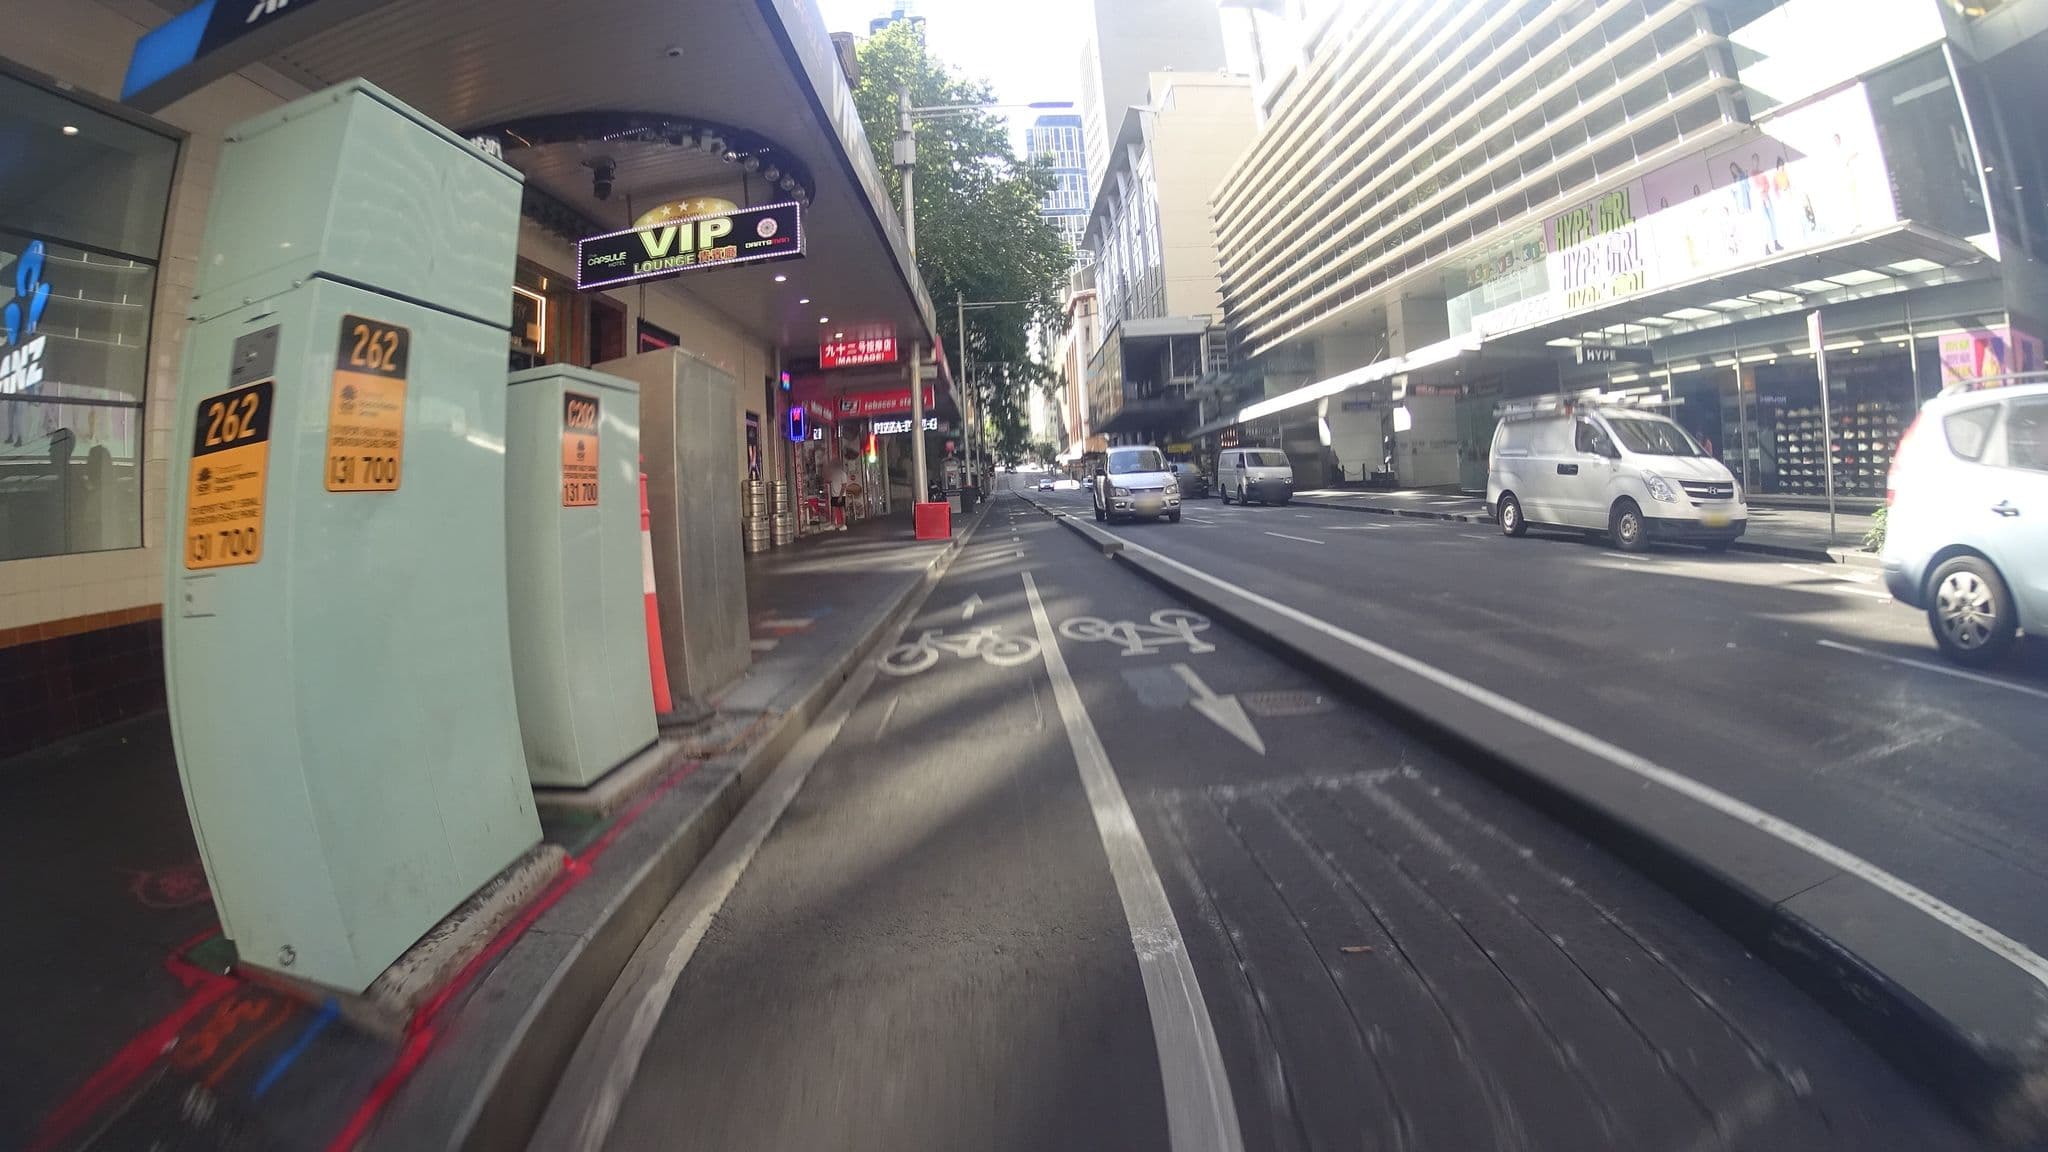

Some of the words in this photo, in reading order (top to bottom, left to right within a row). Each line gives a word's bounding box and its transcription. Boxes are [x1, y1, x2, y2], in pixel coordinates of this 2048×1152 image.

[1555, 203, 1594, 252] HYPE
[1598, 187, 1636, 234] GIRL
[638, 216, 733, 259] VIP
[587, 251, 627, 266] CAPSULE
[608, 260, 626, 268] HOTEL
[634, 252, 696, 274] LOUNGE
[1563, 241, 1605, 291] HYPE
[351, 324, 398, 371] 262
[1586, 348, 1616, 361] HYPE
[205, 391, 259, 447] 262
[331, 455, 355, 484] 131
[362, 456, 397, 483] 700
[563, 482, 579, 502] 131
[582, 482, 597, 501] 700
[219, 527, 257, 558] 700
